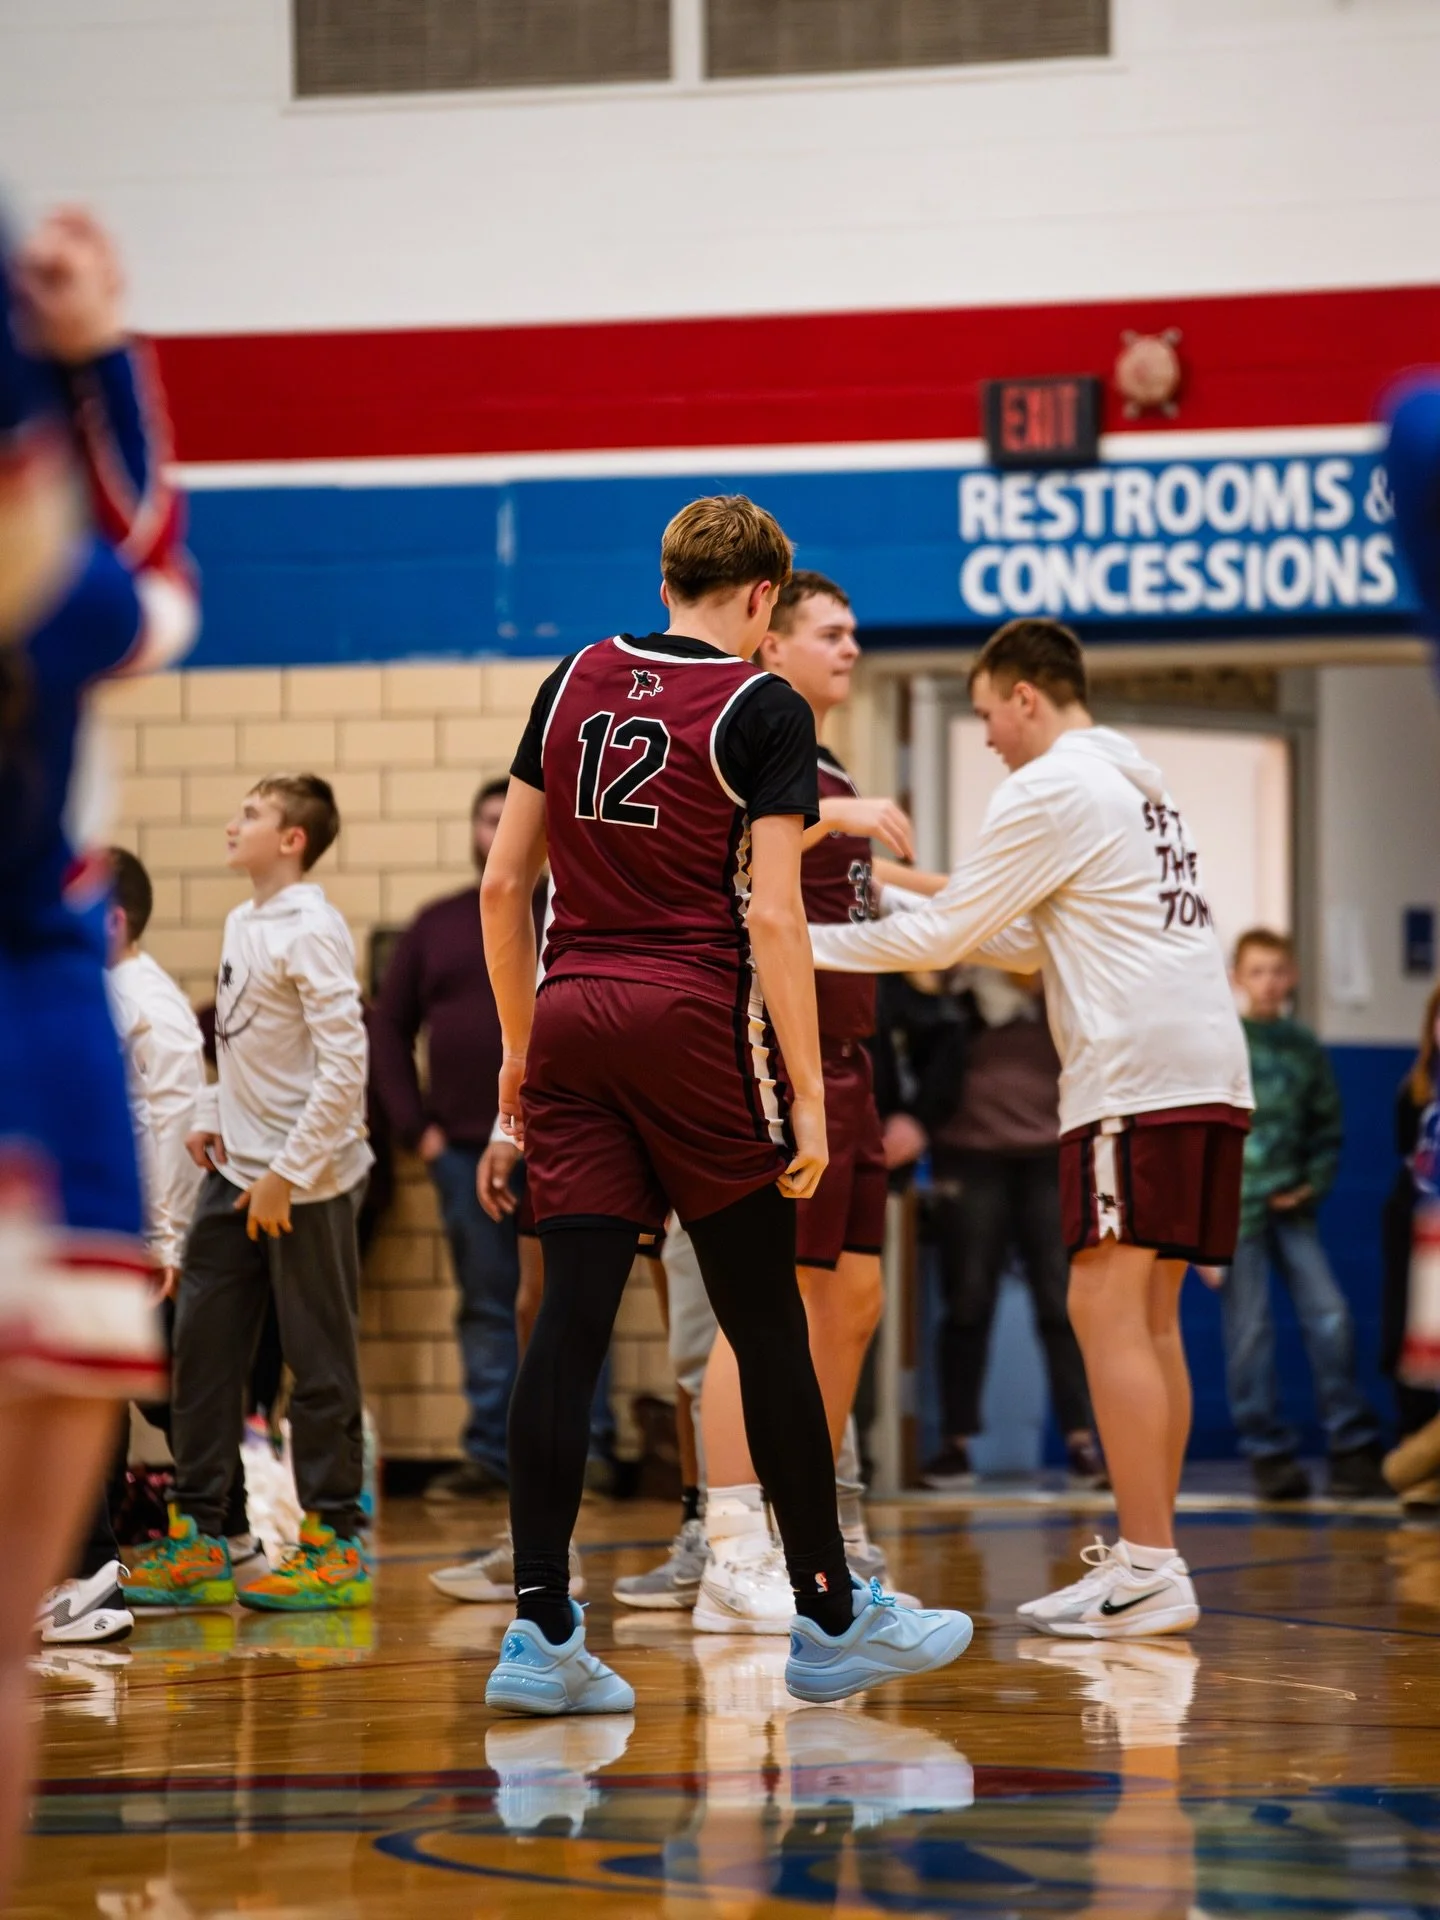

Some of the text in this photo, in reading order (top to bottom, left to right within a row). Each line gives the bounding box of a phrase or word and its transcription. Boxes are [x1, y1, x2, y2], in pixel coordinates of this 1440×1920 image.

[1001, 386, 1077, 450] EXIT
[959, 460, 1396, 541] RESTROOMS &
[960, 535, 1396, 615] CONCESSIONS
[575, 711, 670, 828] 12
[1155, 845, 1197, 885] THE
